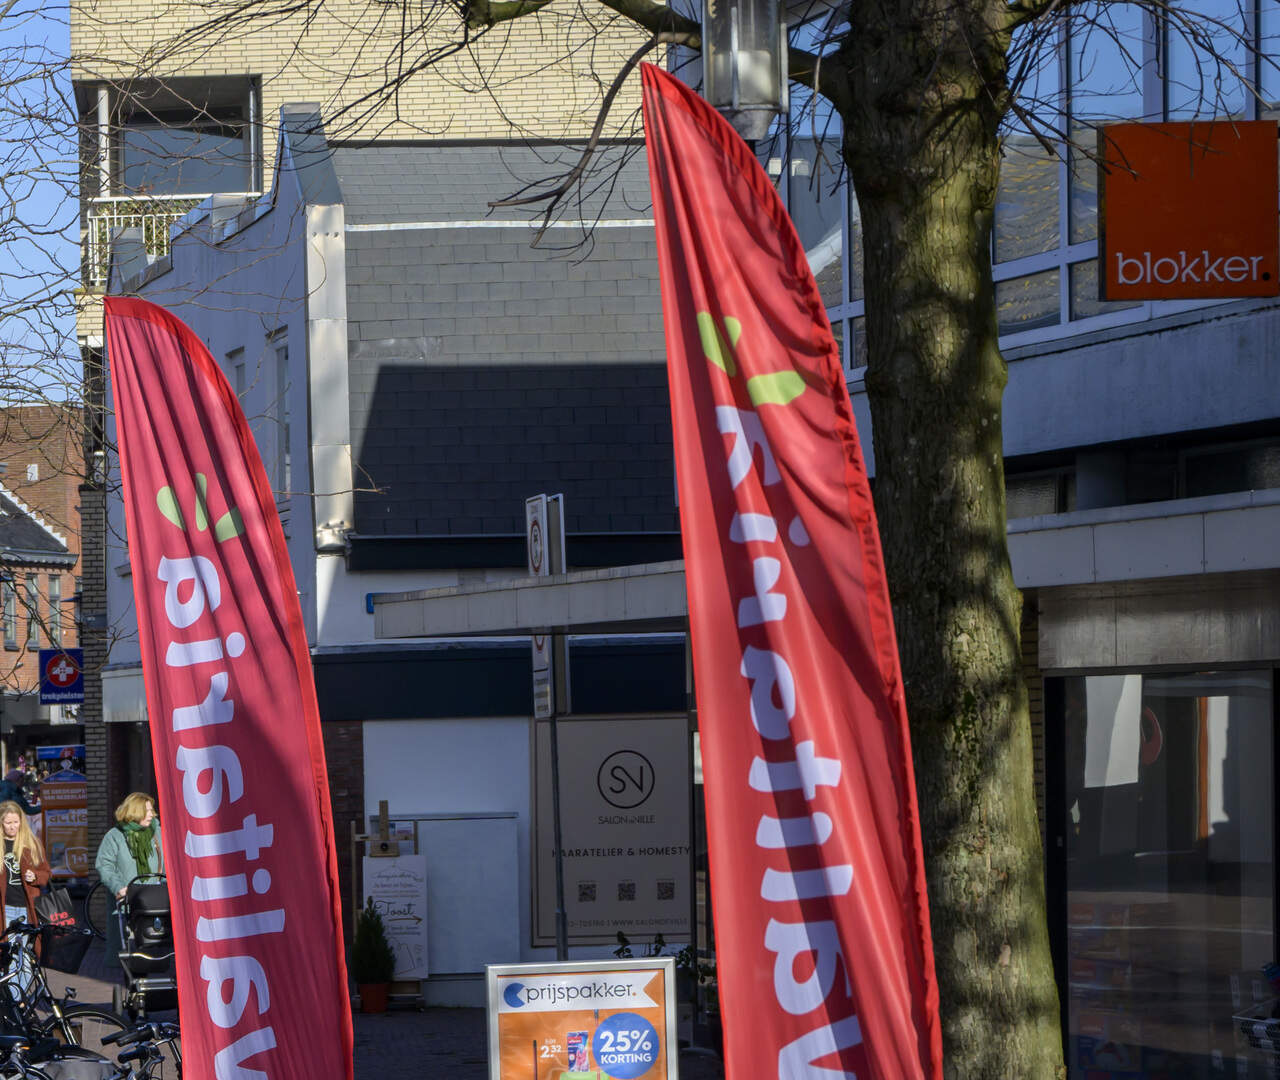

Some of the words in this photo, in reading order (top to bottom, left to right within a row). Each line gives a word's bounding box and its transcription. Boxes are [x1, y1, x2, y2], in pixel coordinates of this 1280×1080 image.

[609, 765, 644, 794] SN
[599, 1029, 653, 1053] 25%
[600, 1052, 653, 1065] KORTING
